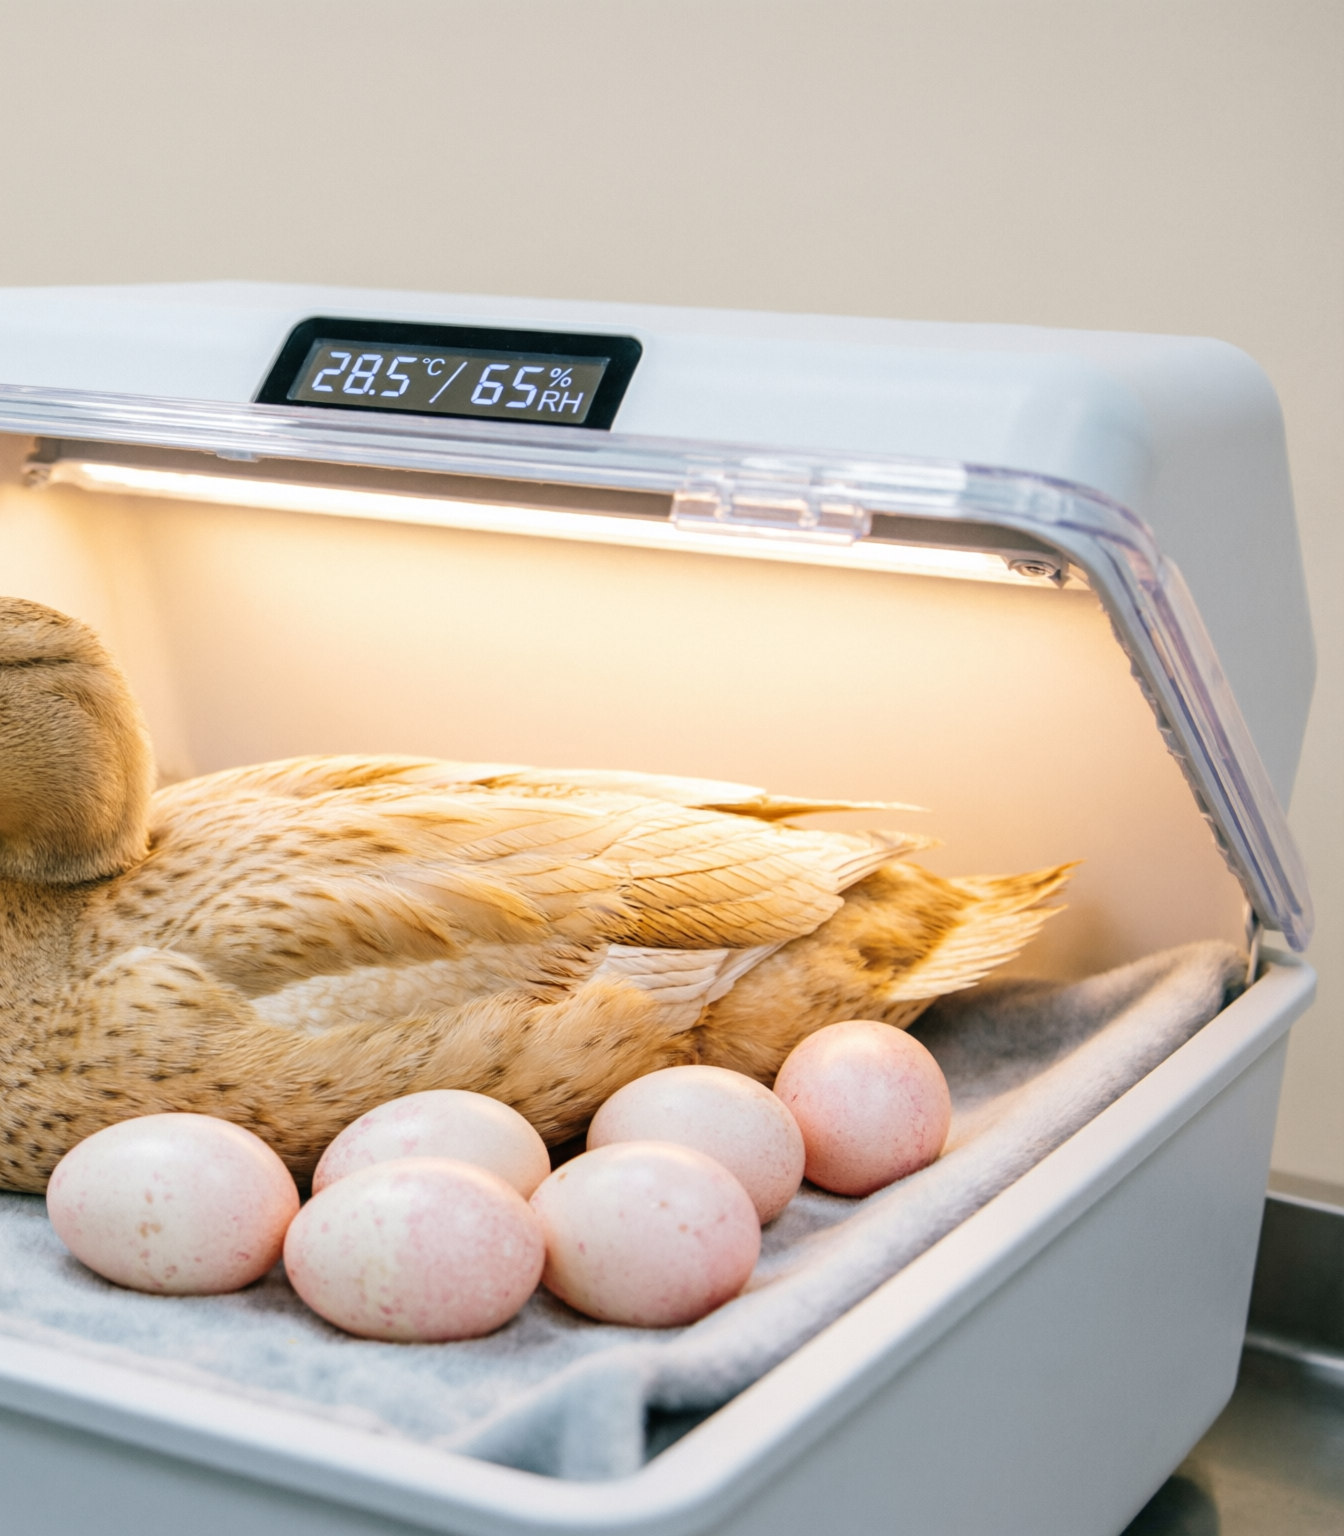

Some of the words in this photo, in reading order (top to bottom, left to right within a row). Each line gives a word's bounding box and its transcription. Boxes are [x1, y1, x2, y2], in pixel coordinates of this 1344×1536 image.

[312, 351, 445, 397] 28.5°C
[428, 361, 468, 404] /
[537, 390, 584, 414] RH
